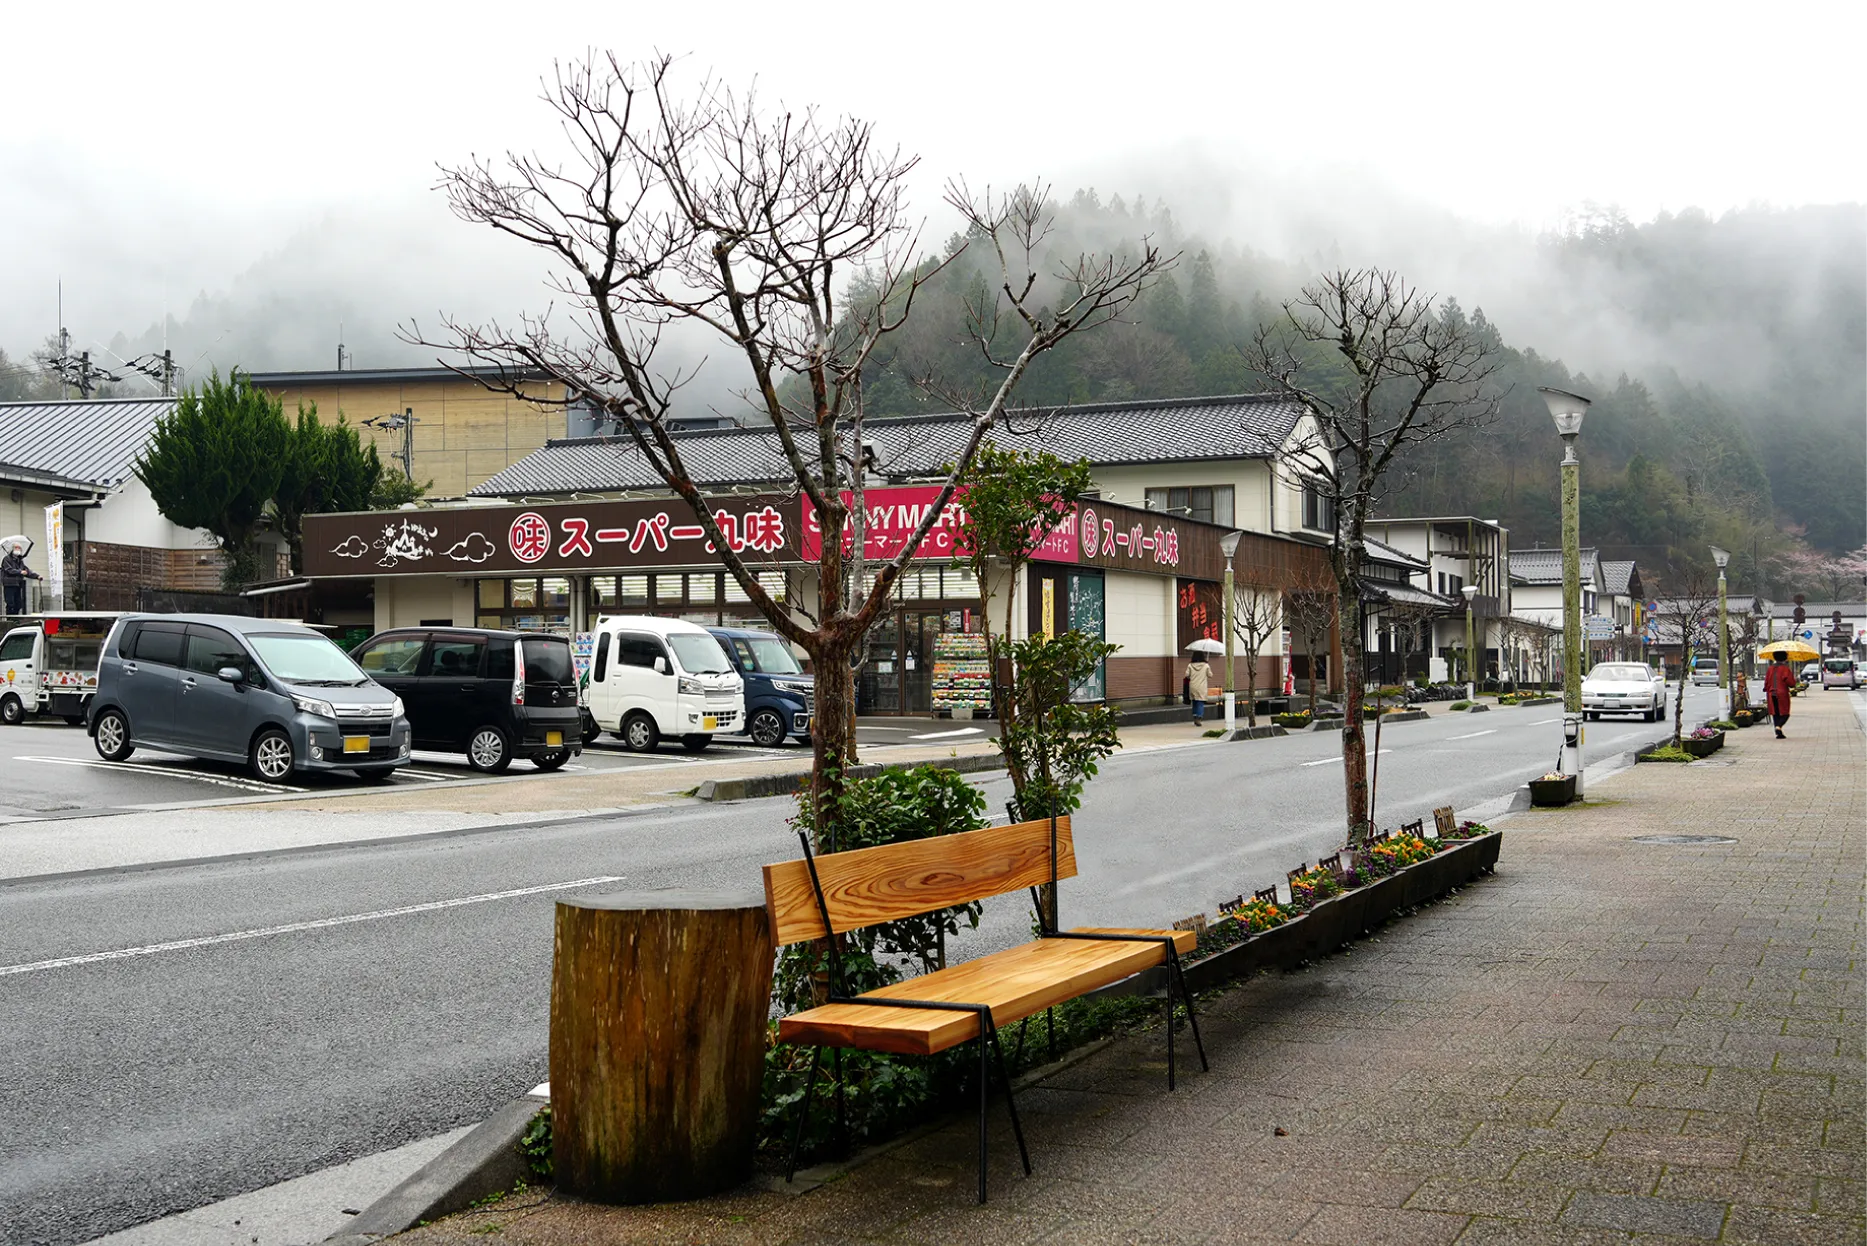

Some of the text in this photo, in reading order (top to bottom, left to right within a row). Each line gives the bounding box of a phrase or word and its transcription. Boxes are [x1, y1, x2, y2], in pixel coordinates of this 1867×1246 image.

[809, 504, 895, 532] SNNY
[511, 506, 784, 560] 味 スーパー丸味
[1102, 518, 1179, 567] スーパー丸味
[1180, 582, 1196, 609] お酒
[1192, 602, 1207, 629] 弁当
